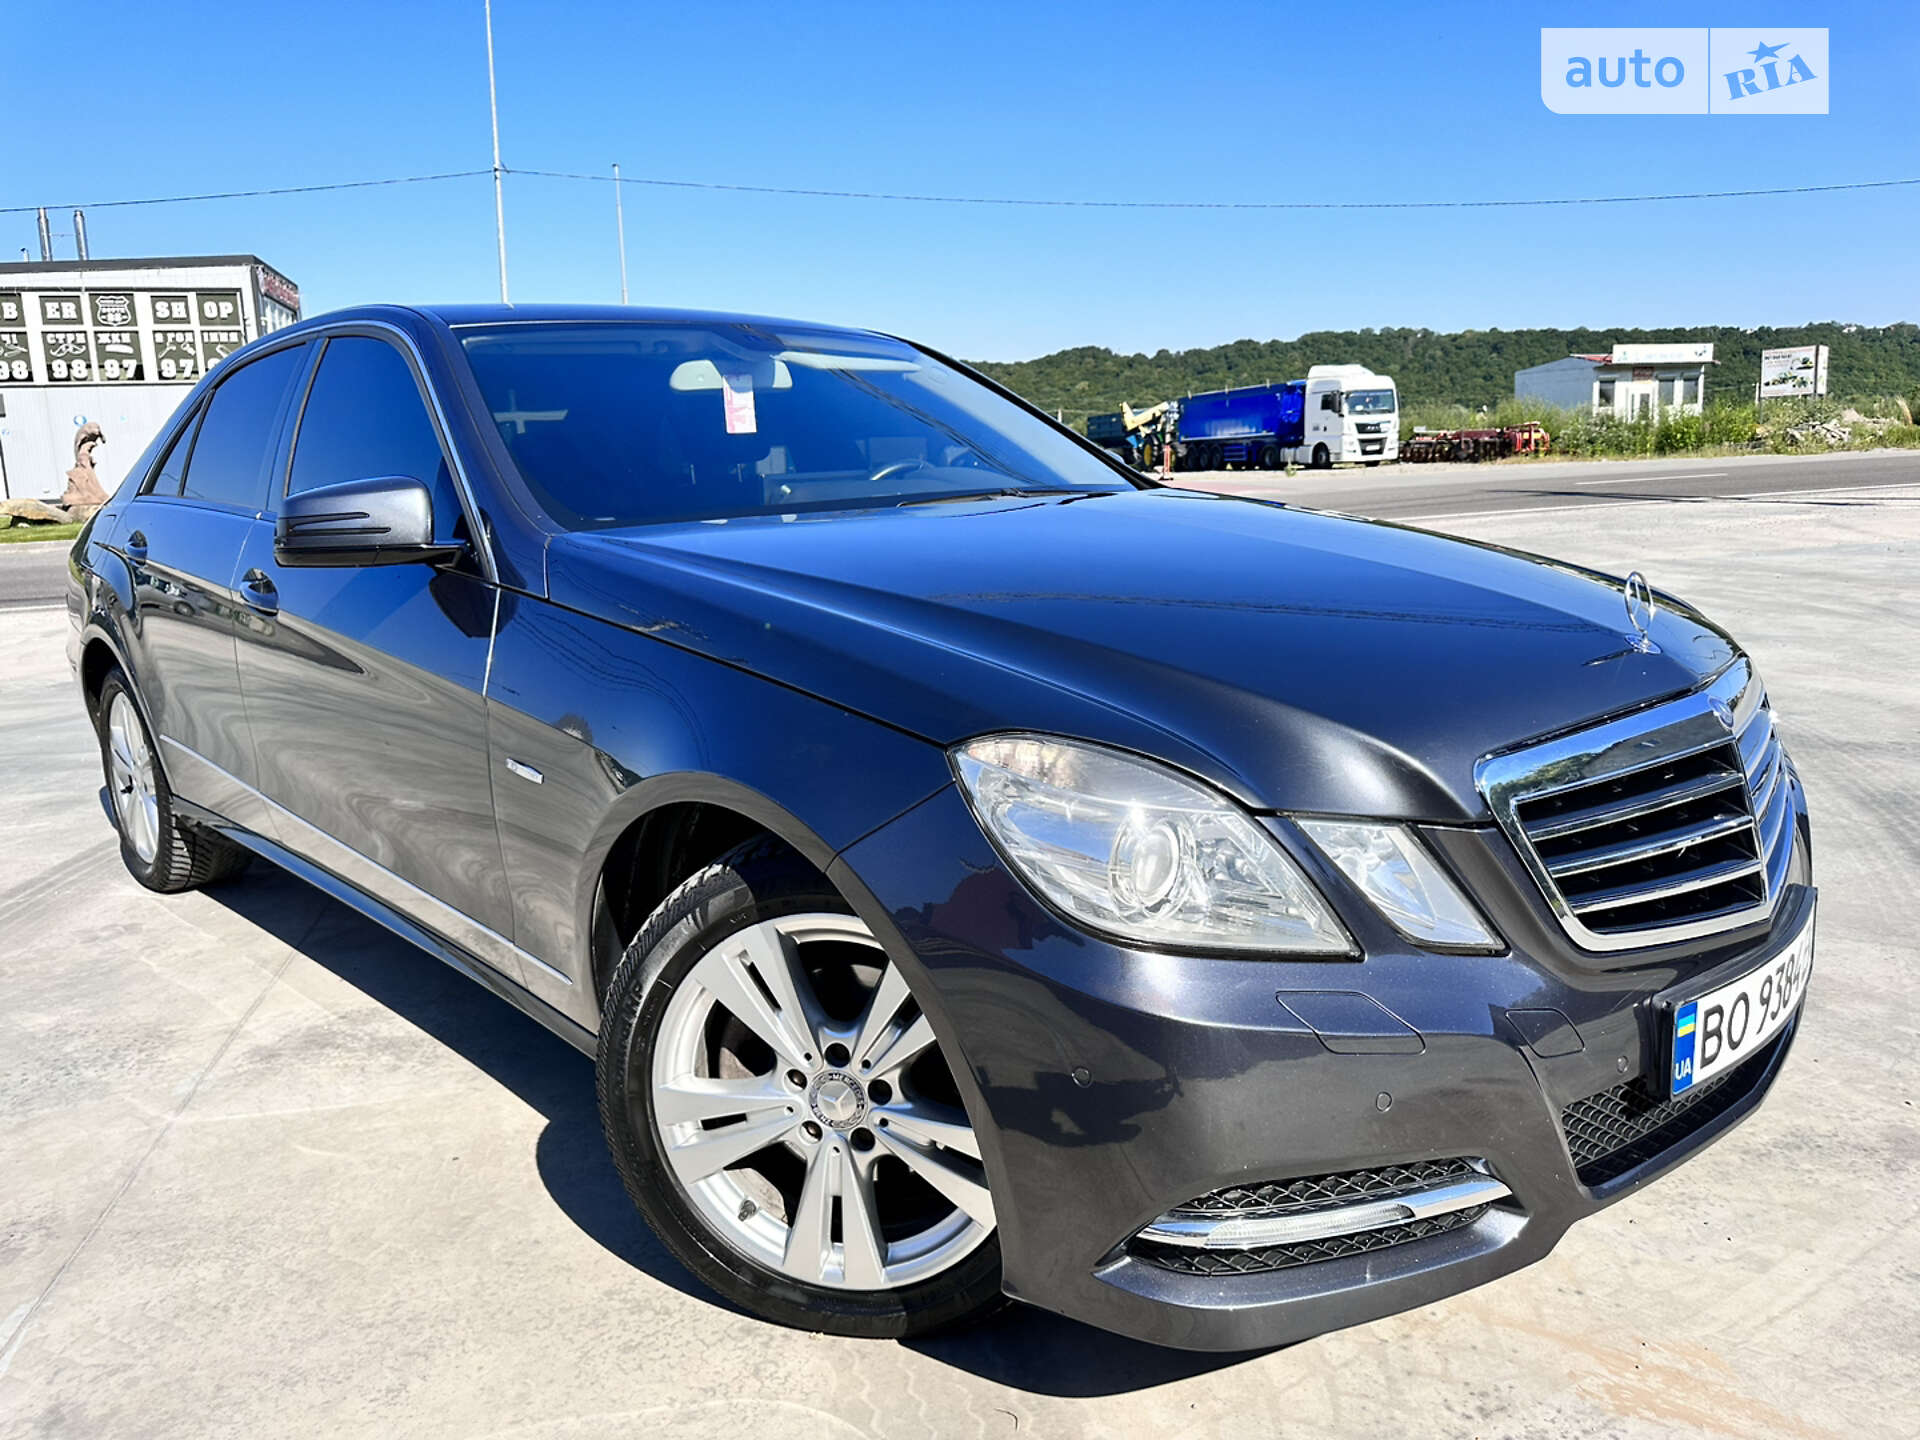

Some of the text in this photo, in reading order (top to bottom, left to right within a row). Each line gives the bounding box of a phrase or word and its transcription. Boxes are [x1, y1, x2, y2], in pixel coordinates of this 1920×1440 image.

[44, 301, 78, 320] ER
[154, 301, 188, 319] SH
[203, 301, 234, 319] OP
[51, 359, 89, 379] 98
[103, 358, 138, 379] 97
[160, 358, 194, 379] 97
[1700, 991, 1750, 1070] BO
[1675, 1057, 1692, 1081] UA
